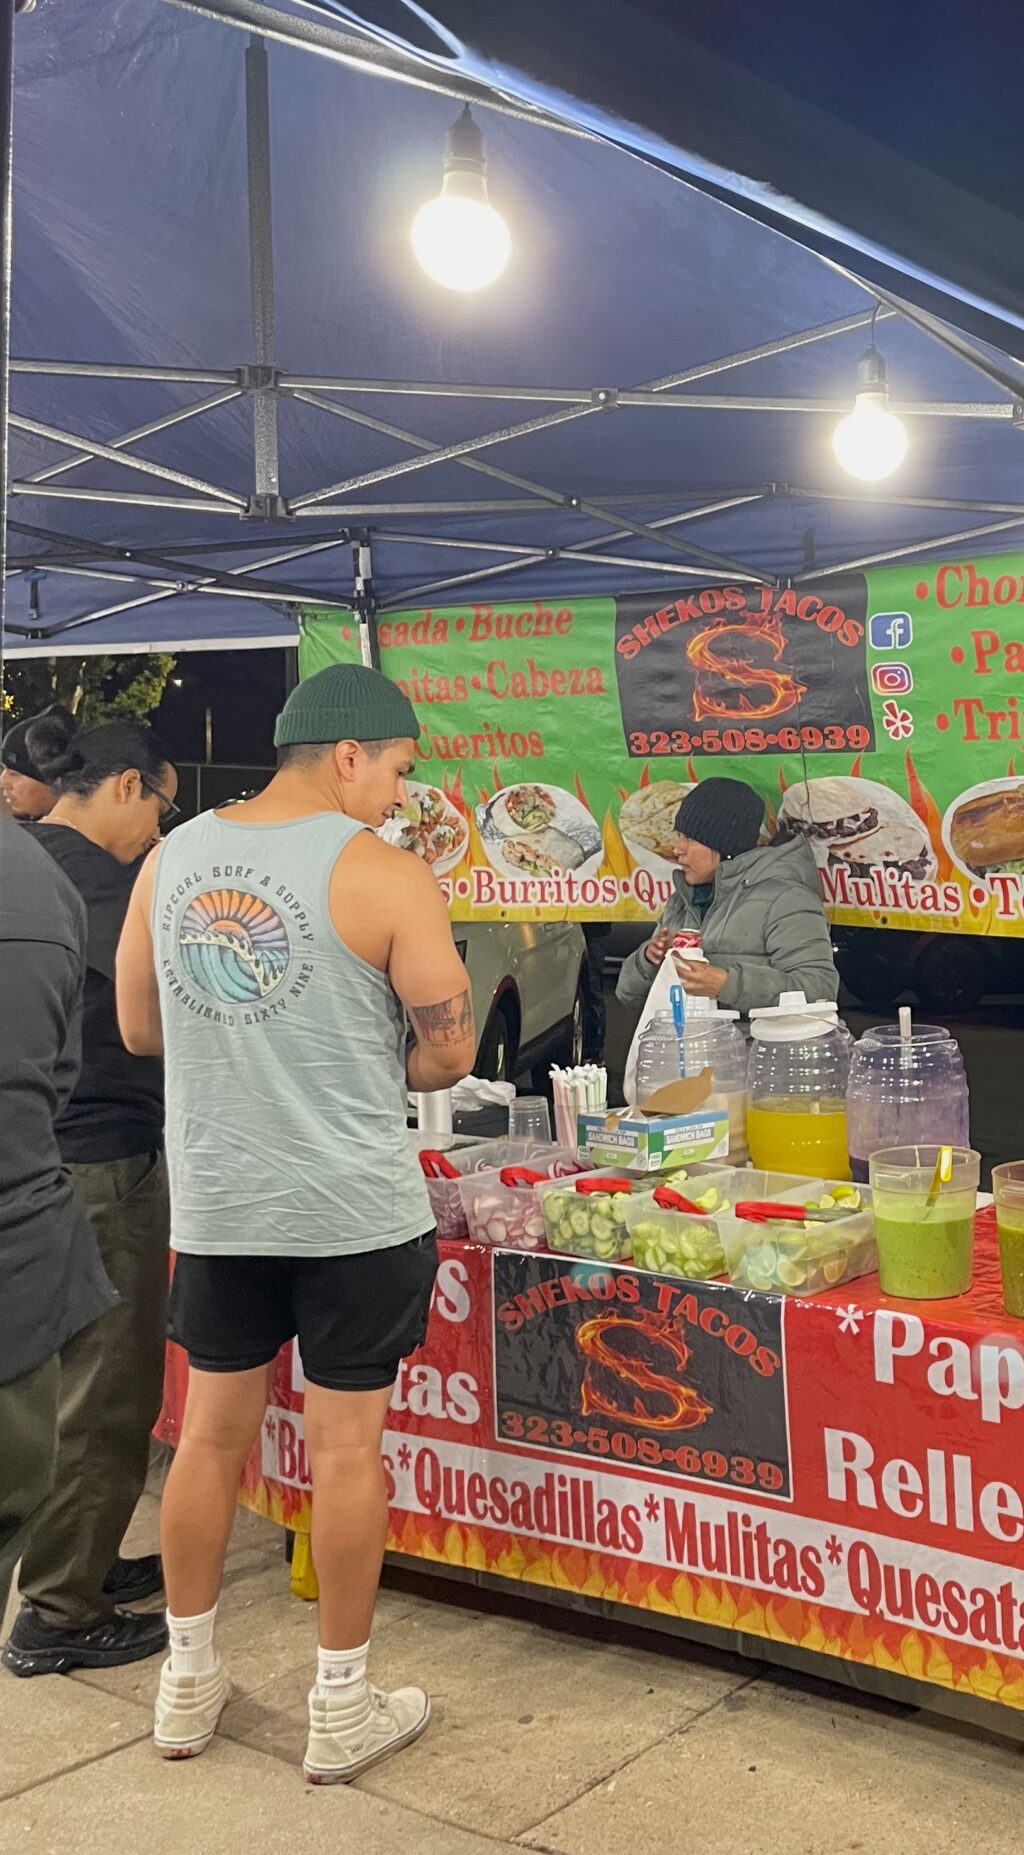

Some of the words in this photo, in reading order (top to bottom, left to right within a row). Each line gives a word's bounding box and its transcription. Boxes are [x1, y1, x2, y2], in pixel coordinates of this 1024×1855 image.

[357, 607, 448, 650] sada
[467, 602, 573, 642] Buche
[616, 586, 746, 660] SHEKOS
[754, 585, 865, 647] TACOS
[486, 658, 606, 700] Cabeza
[414, 720, 544, 761] Cueritos
[473, 868, 618, 907] Burritos
[820, 866, 960, 913] Mulitas
[244, 998, 287, 1025] SIXTY
[496, 1274, 640, 1332] SHEKOS
[653, 1281, 782, 1377] TACOS
[414, 1447, 643, 1555] Quesadillas
[663, 1497, 826, 1598] Mulitas
